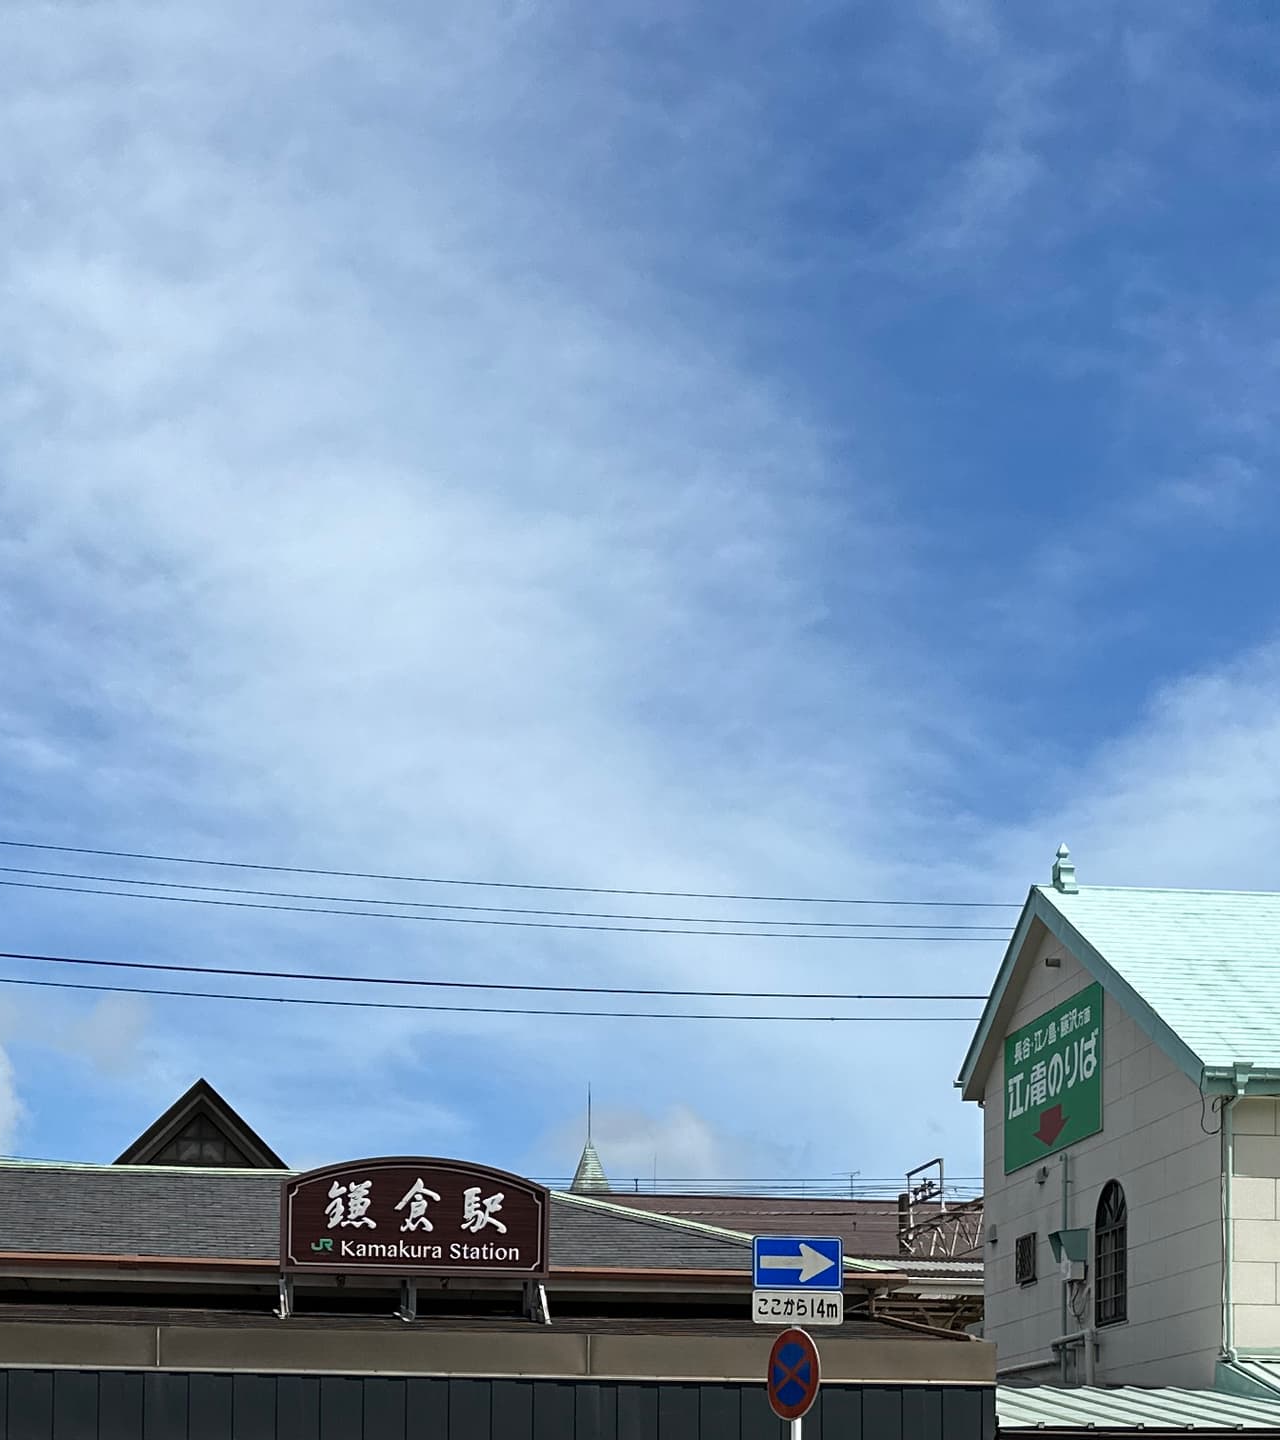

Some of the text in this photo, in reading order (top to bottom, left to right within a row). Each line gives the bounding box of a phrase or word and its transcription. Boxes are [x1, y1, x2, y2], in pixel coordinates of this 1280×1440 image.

[1008, 1027, 1099, 1120] 江ノ電のりば
[324, 1177, 508, 1234] 鎌倉駅
[311, 1238, 521, 1261] JR Kamakura Station
[757, 1297, 838, 1318] ここから14m
